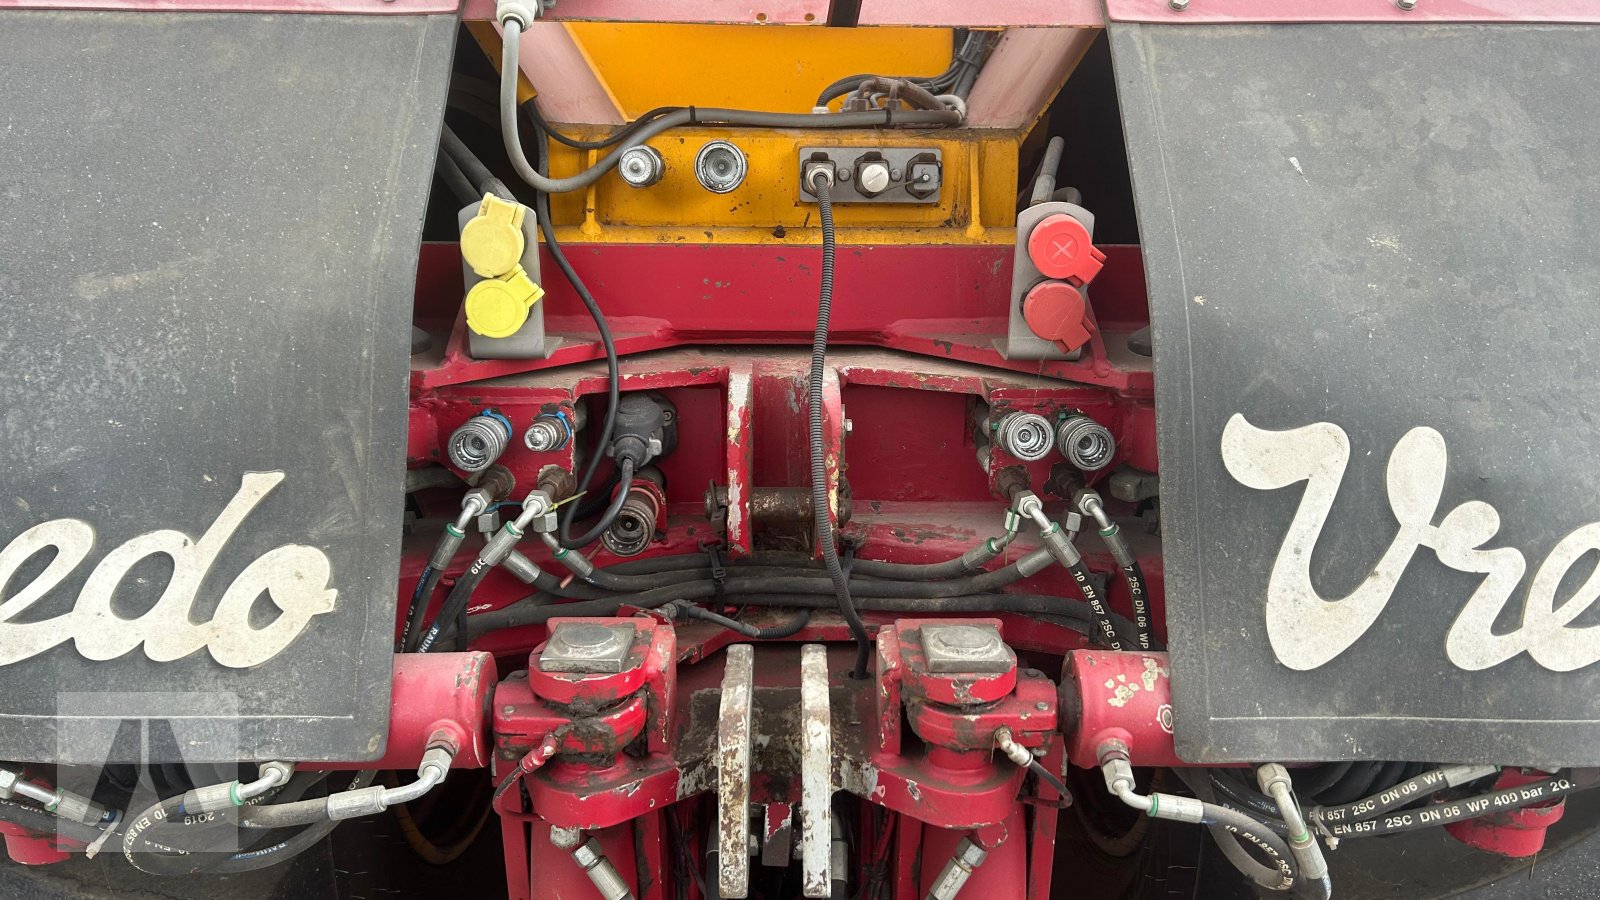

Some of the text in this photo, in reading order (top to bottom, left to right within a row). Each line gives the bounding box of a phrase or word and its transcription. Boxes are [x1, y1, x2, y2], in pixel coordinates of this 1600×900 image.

[1128, 576, 1142, 595] 2SC
[1074, 571, 1085, 582] 10
[1082, 585, 1096, 599] EN
[1091, 600, 1105, 615] 857
[1101, 619, 1115, 638] 2SC
[1135, 600, 1146, 614] DN
[1137, 616, 1146, 628] 06
[1139, 633, 1149, 649] WP
[1327, 809, 1345, 820] 857
[1352, 800, 1375, 816] 2SC
[1380, 790, 1400, 804] DN
[1402, 781, 1418, 795] 06
[154, 808, 168, 820] 10
[1334, 824, 1352, 834] EN
[1355, 821, 1377, 832] 857
[1385, 815, 1412, 828] 2SC
[1420, 808, 1440, 823] DN
[1443, 806, 1460, 818] 06
[1467, 799, 1489, 813] WP
[1494, 792, 1518, 807] 400
[1520, 786, 1543, 800] bar
[136, 816, 151, 831] EN
